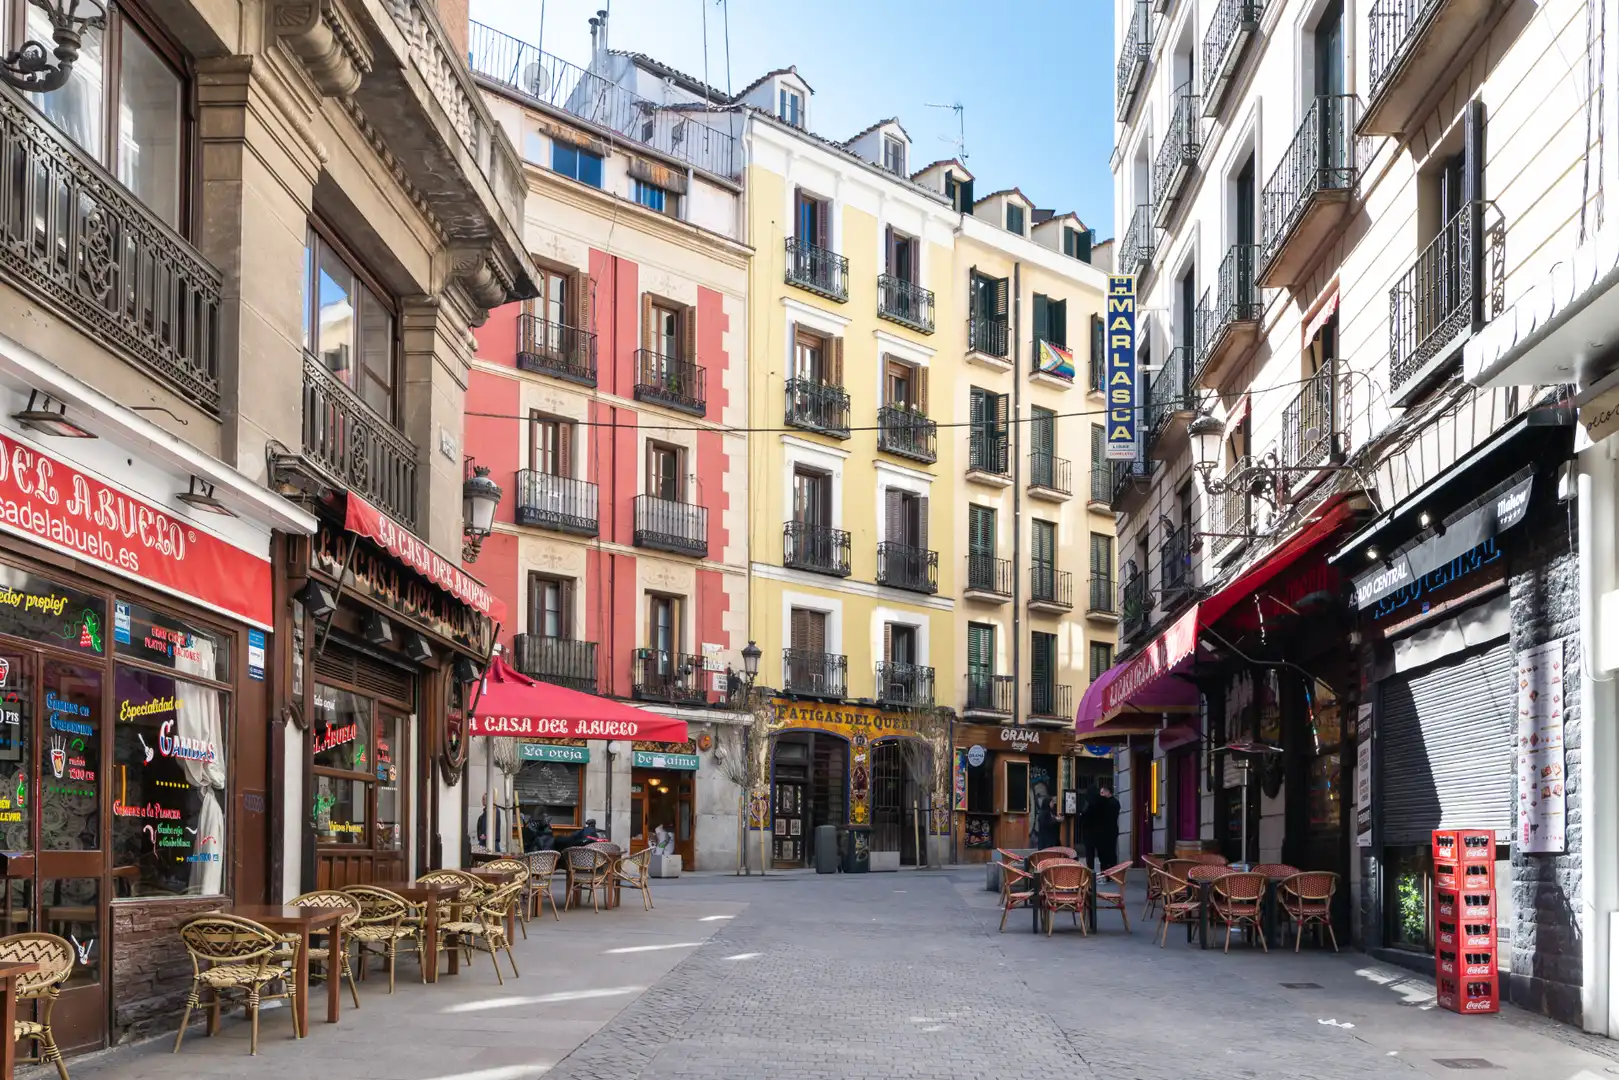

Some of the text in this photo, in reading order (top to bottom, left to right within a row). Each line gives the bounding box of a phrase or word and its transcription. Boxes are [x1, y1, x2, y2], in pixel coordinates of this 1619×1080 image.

[1109, 298, 1133, 440] MARLASCA
[1497, 490, 1526, 518] Mahou
[67, 475, 187, 561] ABUELO
[318, 527, 347, 567] LA
[354, 549, 400, 604] CASA
[379, 516, 490, 613] LA CASA DEL ABUELO
[1373, 561, 1408, 595] CENTRAL
[151, 624, 167, 640] GRAN
[144, 636, 167, 653] PLATOS
[173, 646, 200, 664] RACIONES
[6, 711, 20, 722] PTS
[120, 696, 175, 722] Especialidad
[776, 704, 918, 731] FATIGAS DEL QUER
[321, 720, 358, 749] ABUELO
[484, 716, 532, 733] CASA
[536, 717, 569, 733] DEL
[574, 720, 638, 736] ABUELO
[1000, 729, 1040, 744] GRAMA
[159, 719, 215, 763] GAMBAS
[524, 743, 582, 761] La oreja
[637, 754, 651, 764] de
[1467, 966, 1489, 975] Coca-Cola
[1466, 1000, 1491, 1009] Coca-Cola
